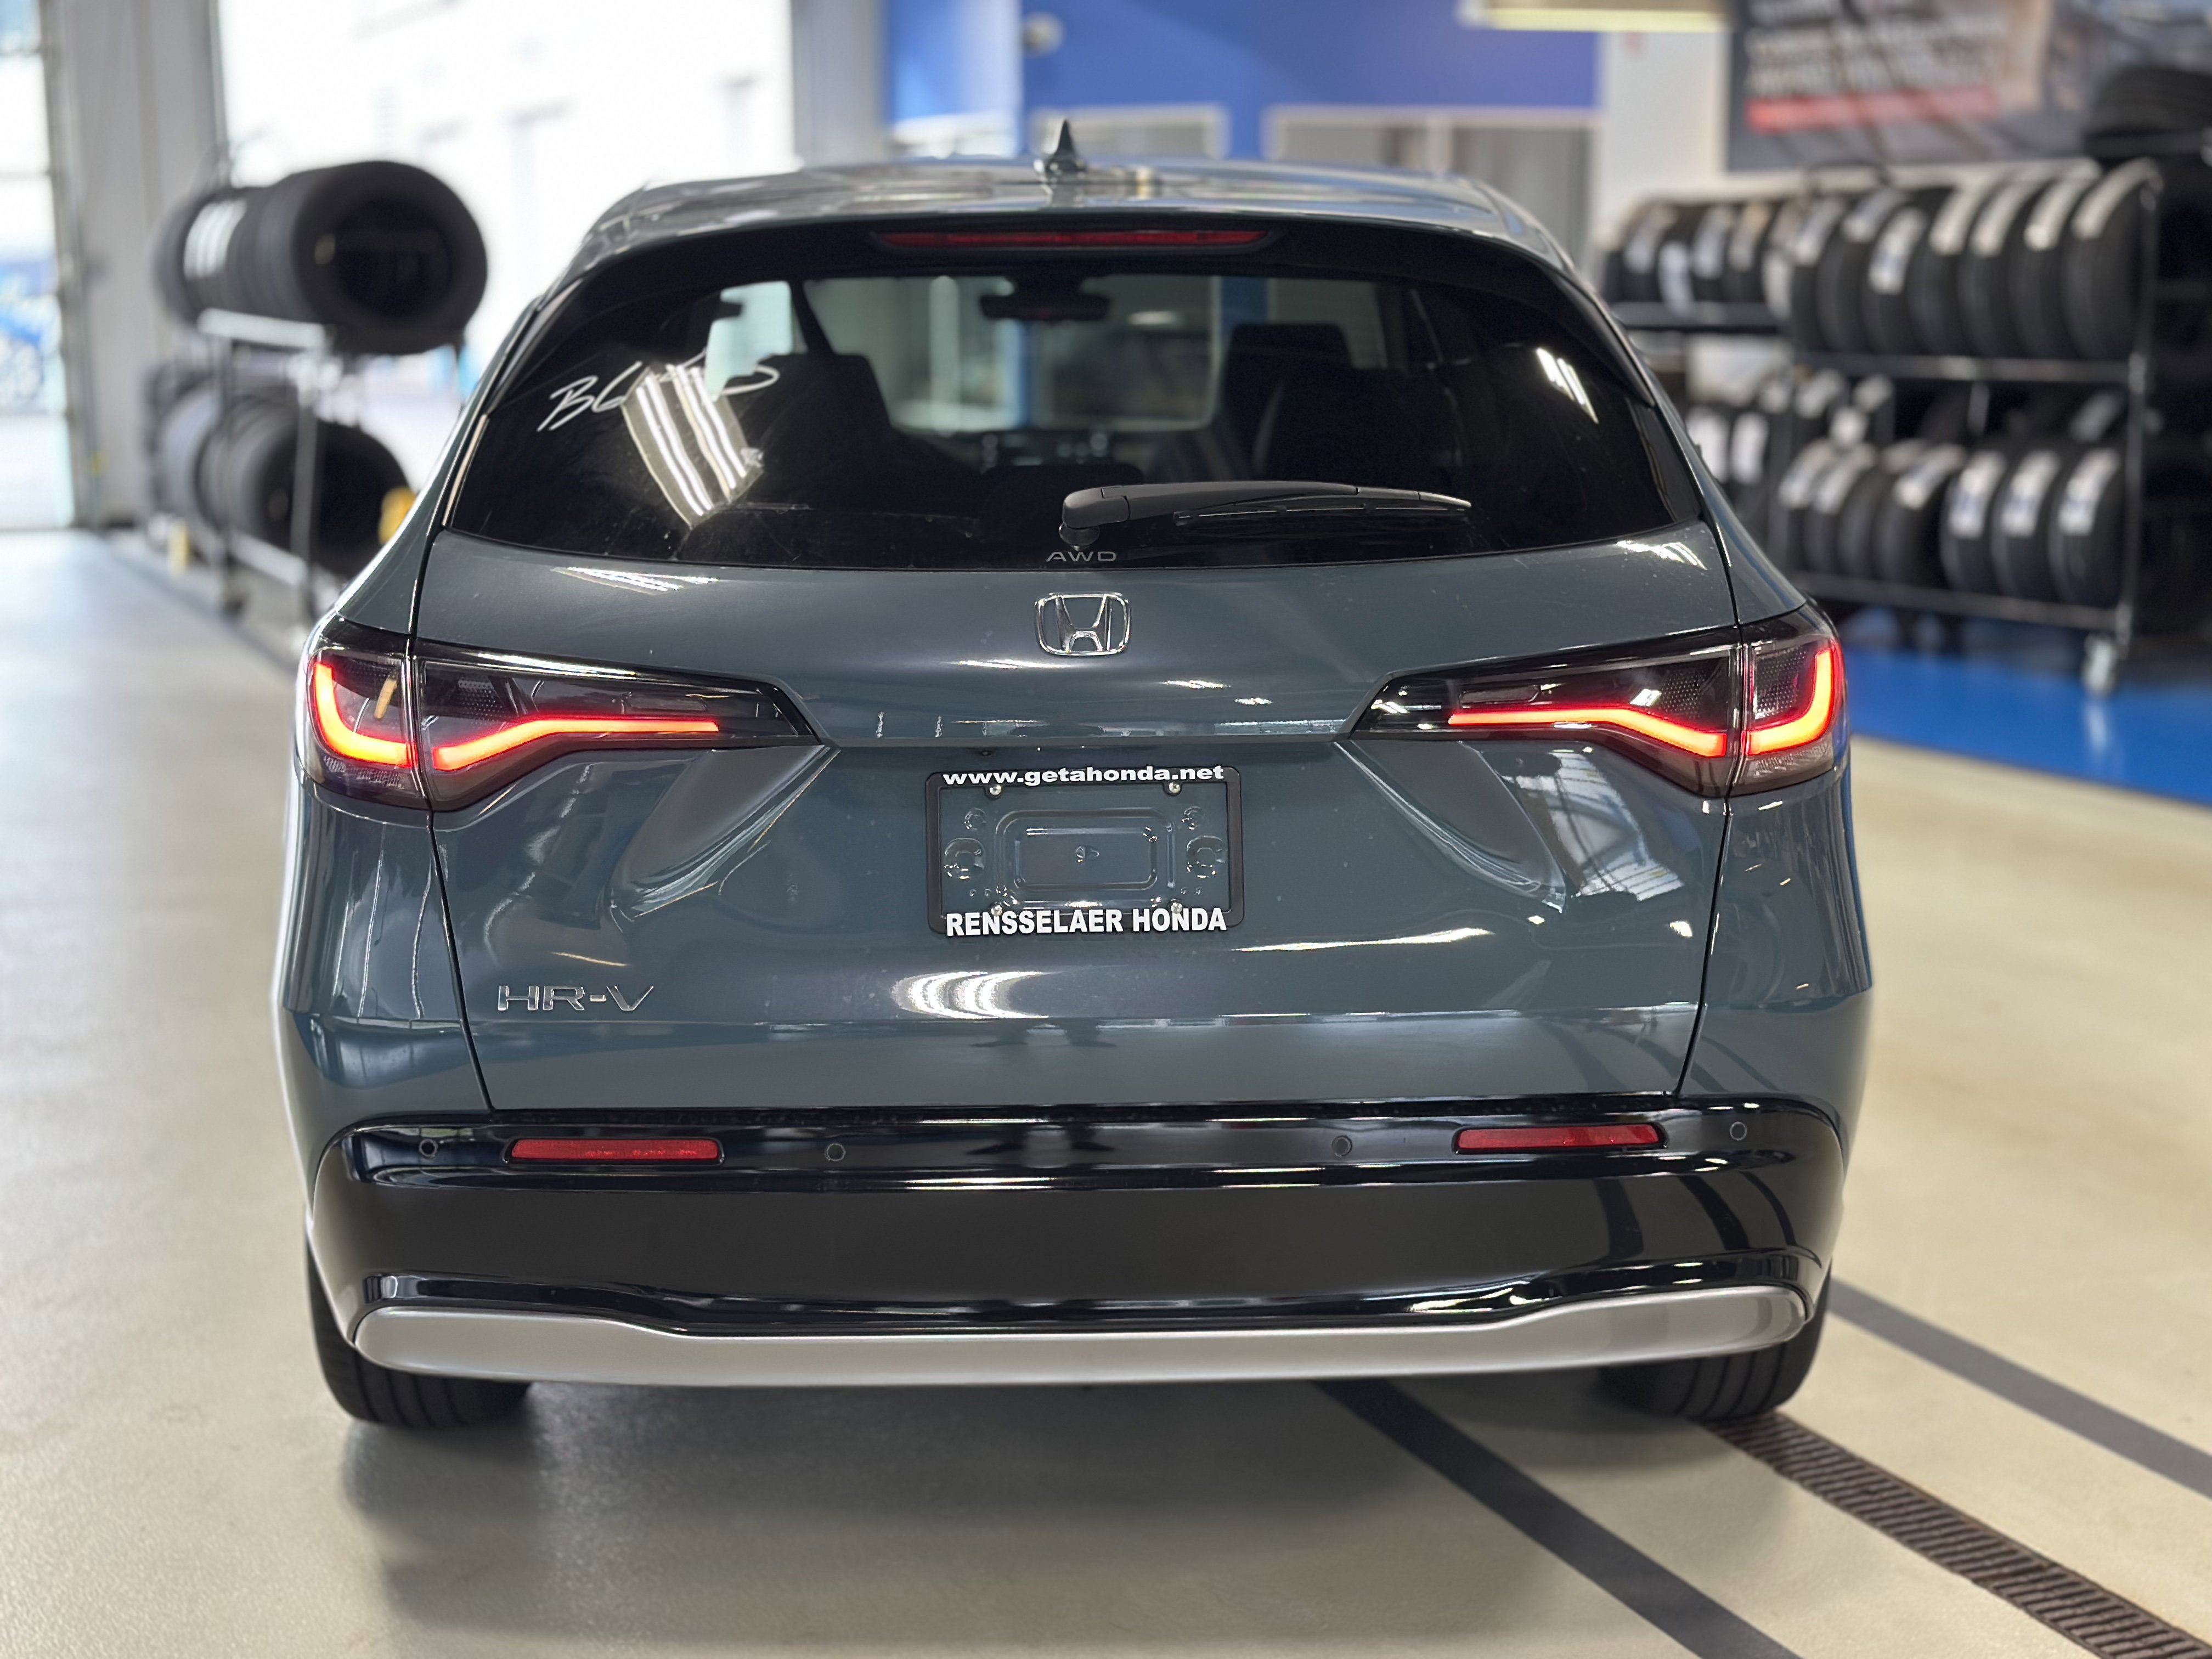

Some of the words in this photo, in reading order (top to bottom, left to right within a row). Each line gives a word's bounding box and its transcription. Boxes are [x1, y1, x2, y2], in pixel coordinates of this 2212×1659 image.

[1047, 551, 1117, 562] AWD
[943, 765, 1224, 786] www.getahonda.net
[946, 909, 1124, 936] RENSSELAER
[1133, 907, 1227, 933] HONDA
[498, 985, 654, 1011] HR-V
